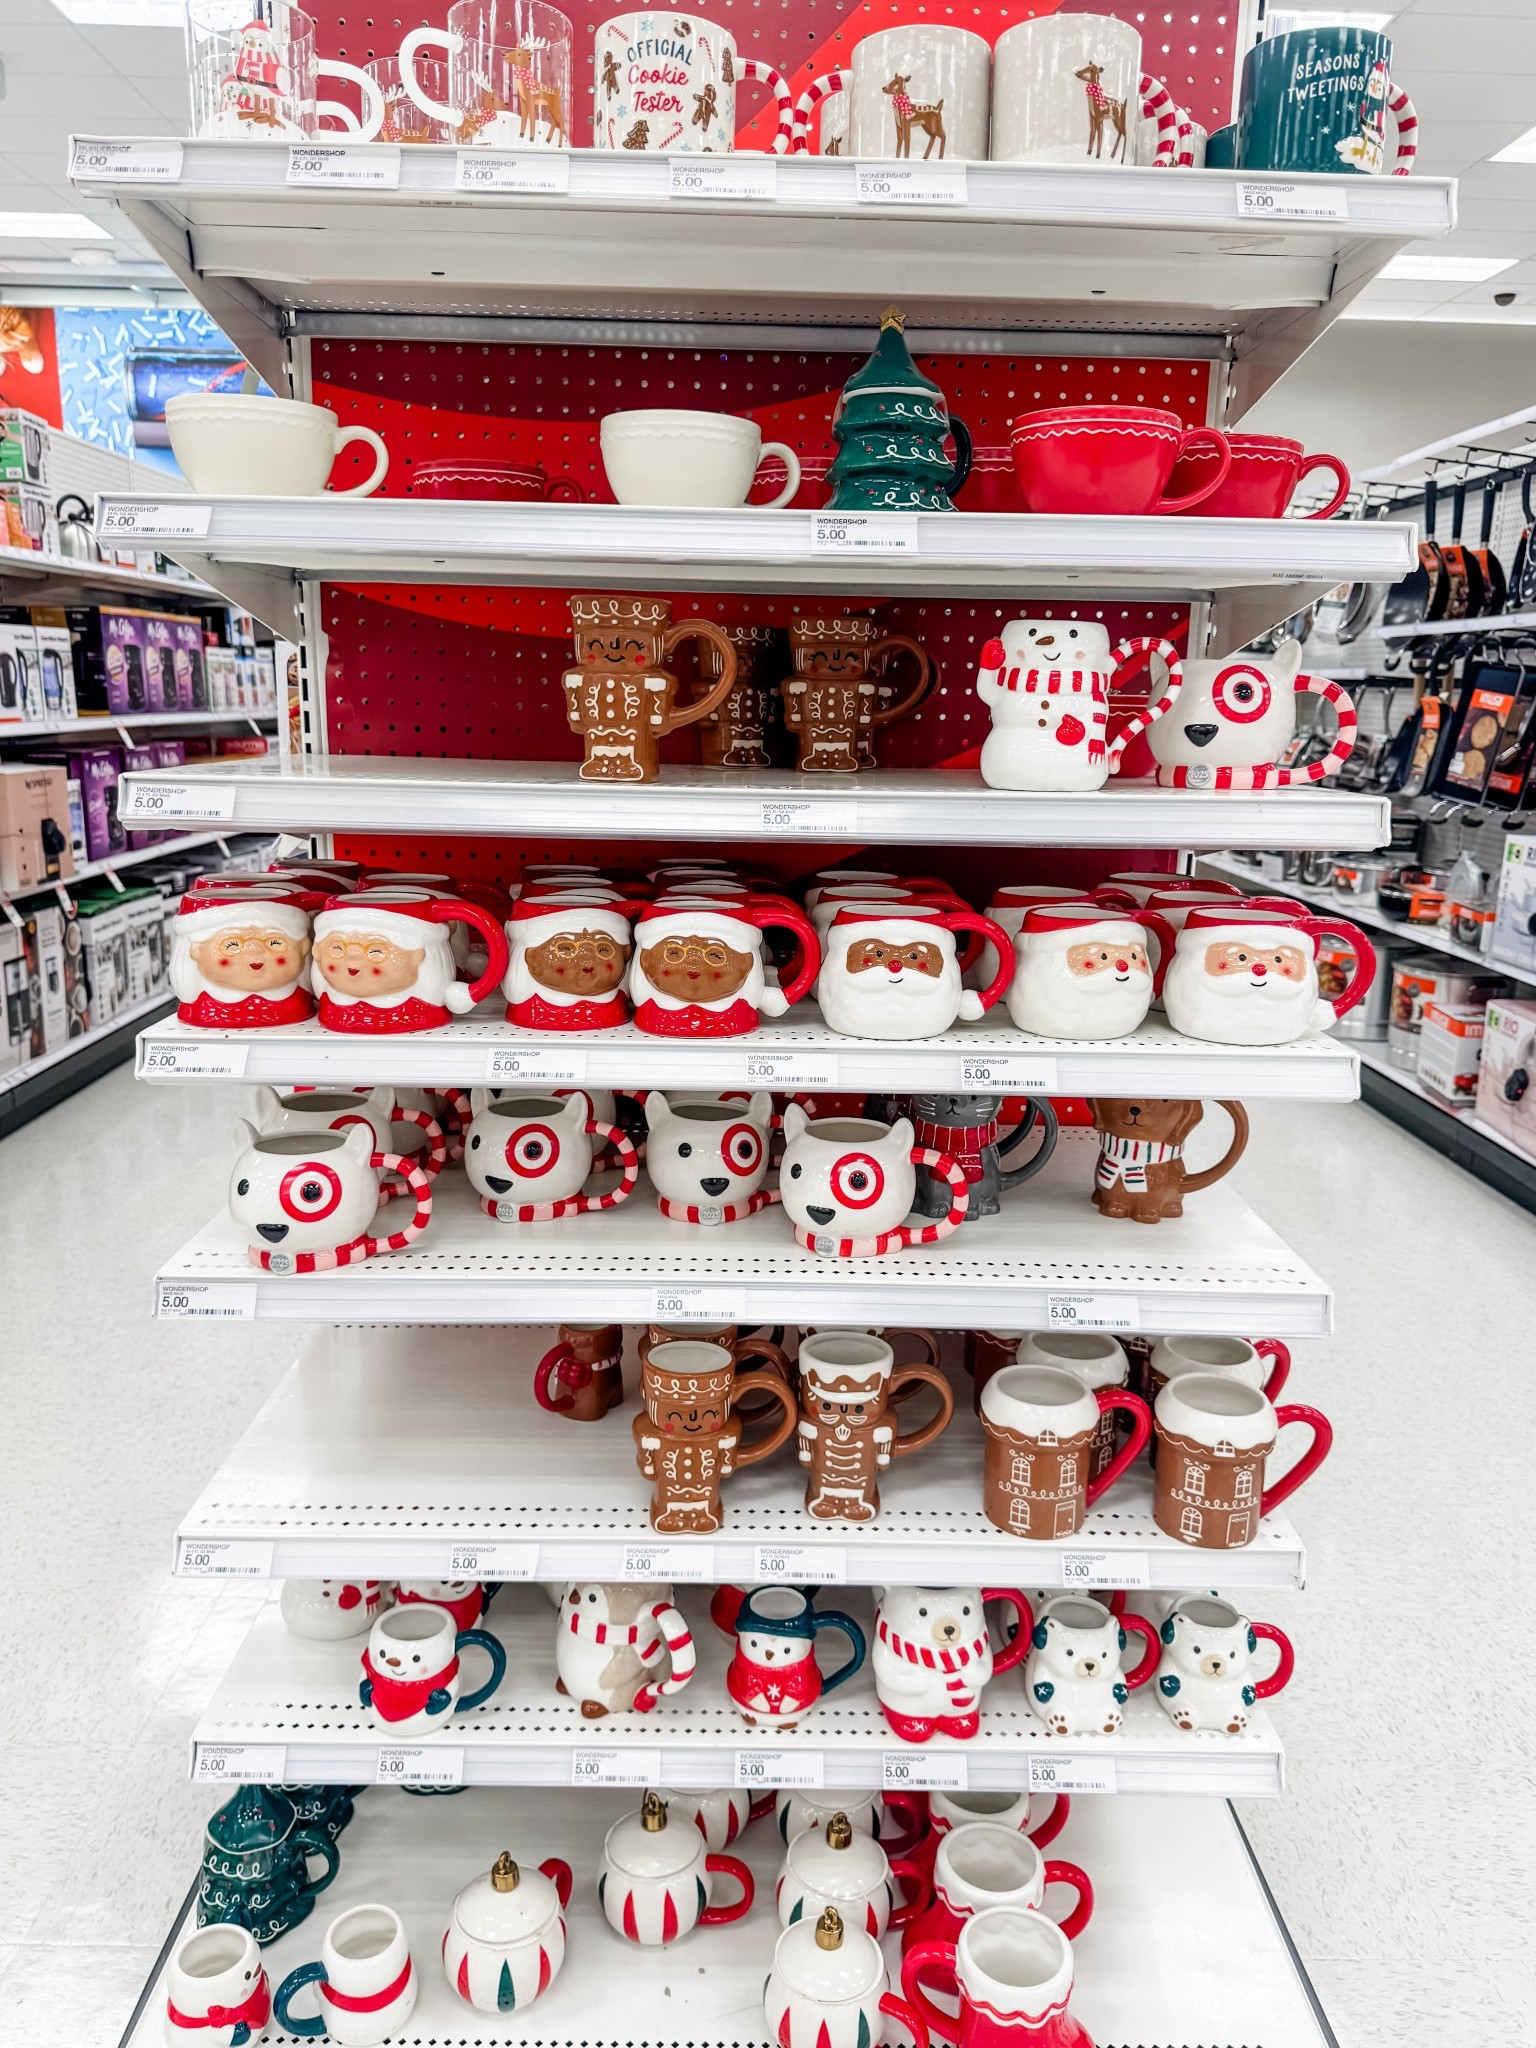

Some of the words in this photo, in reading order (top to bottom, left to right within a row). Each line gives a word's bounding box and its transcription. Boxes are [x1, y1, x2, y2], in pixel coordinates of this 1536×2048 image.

[627, 38, 692, 66] OFFICIAL
[1296, 53, 1360, 80] SEASONS
[628, 63, 690, 86] Cookie
[1287, 75, 1365, 104] TWEETINGS
[633, 90, 684, 113] Tester
[76, 155, 108, 165] 5.00
[463, 159, 517, 167] WONDERSHOP
[291, 161, 322, 171] 5.00
[462, 170, 494, 180] 5.00
[672, 177, 702, 187] 5.00
[861, 183, 891, 193] 5.00
[1243, 184, 1295, 192] WONDERSHOP
[1244, 195, 1273, 206] 5.00
[105, 516, 135, 526] 5.00
[817, 529, 846, 539] 5.00
[1190, 768, 1210, 779] 2025
[134, 797, 163, 808] 5.00
[763, 814, 790, 824] 5.00
[148, 1055, 176, 1066] 5.00
[493, 1060, 520, 1071] 5.00
[747, 1065, 774, 1075] 5.00
[964, 1068, 990, 1079] 5.00
[703, 1210, 720, 1220] 2025
[272, 1258, 290, 1268] 2025
[162, 1296, 189, 1307] 5.00
[657, 1299, 683, 1310] 5.00
[1050, 1307, 1076, 1318] 5.00
[184, 1554, 210, 1565] 5.00
[452, 1558, 477, 1569] 5.00
[626, 1558, 651, 1570] 5.00
[760, 1559, 785, 1570] 5.00
[1064, 1565, 1089, 1576] 5.00
[200, 1759, 225, 1770] 5.00
[380, 1760, 404, 1772] 5.00
[575, 1762, 599, 1774] 5.00
[740, 1764, 764, 1776] 5.00
[885, 1766, 909, 1778] 5.00
[1032, 1769, 1056, 1781] 5.00
